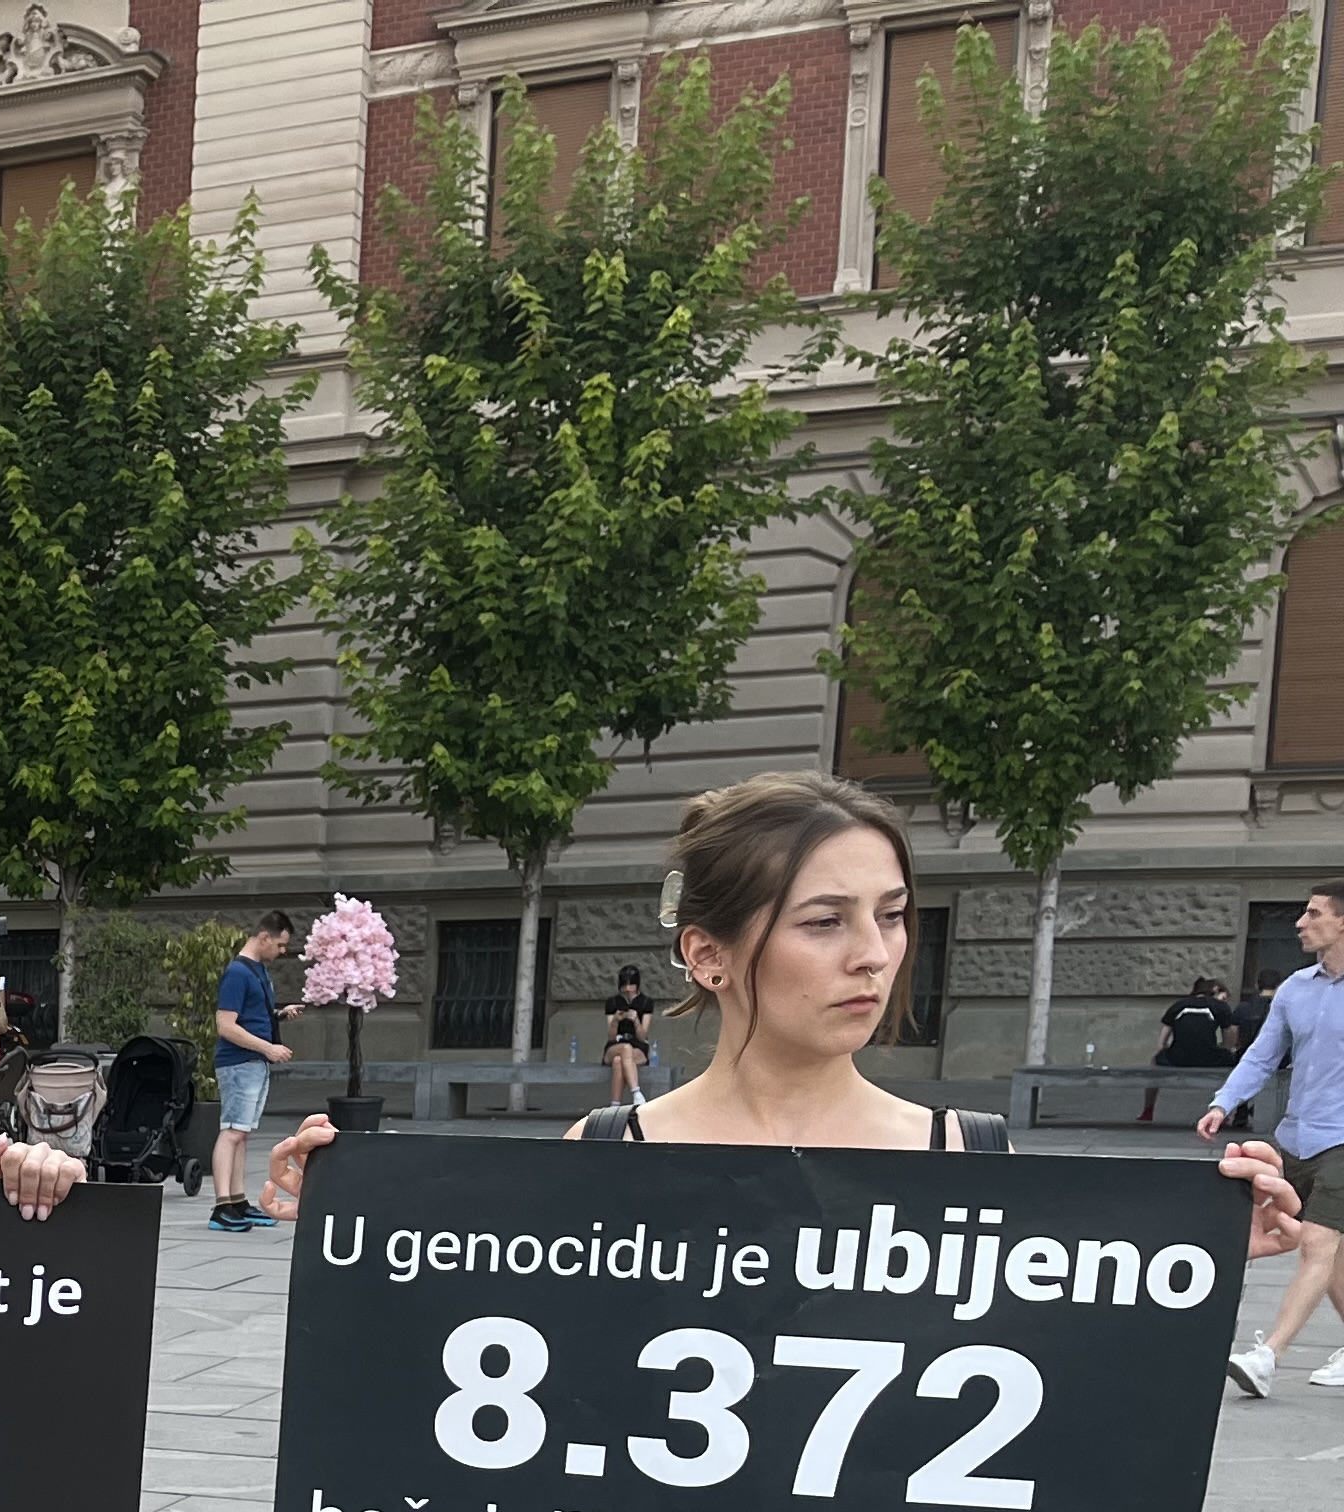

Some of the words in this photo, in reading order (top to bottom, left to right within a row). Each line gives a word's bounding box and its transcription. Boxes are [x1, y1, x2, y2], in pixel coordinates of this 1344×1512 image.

[23, 1264, 82, 1326] je
[322, 1214, 365, 1266] U
[386, 1221, 688, 1283] genocidu
[702, 1227, 770, 1298] je
[794, 1204, 1216, 1321] ubijeno
[434, 1316, 1044, 1511] 8.372
